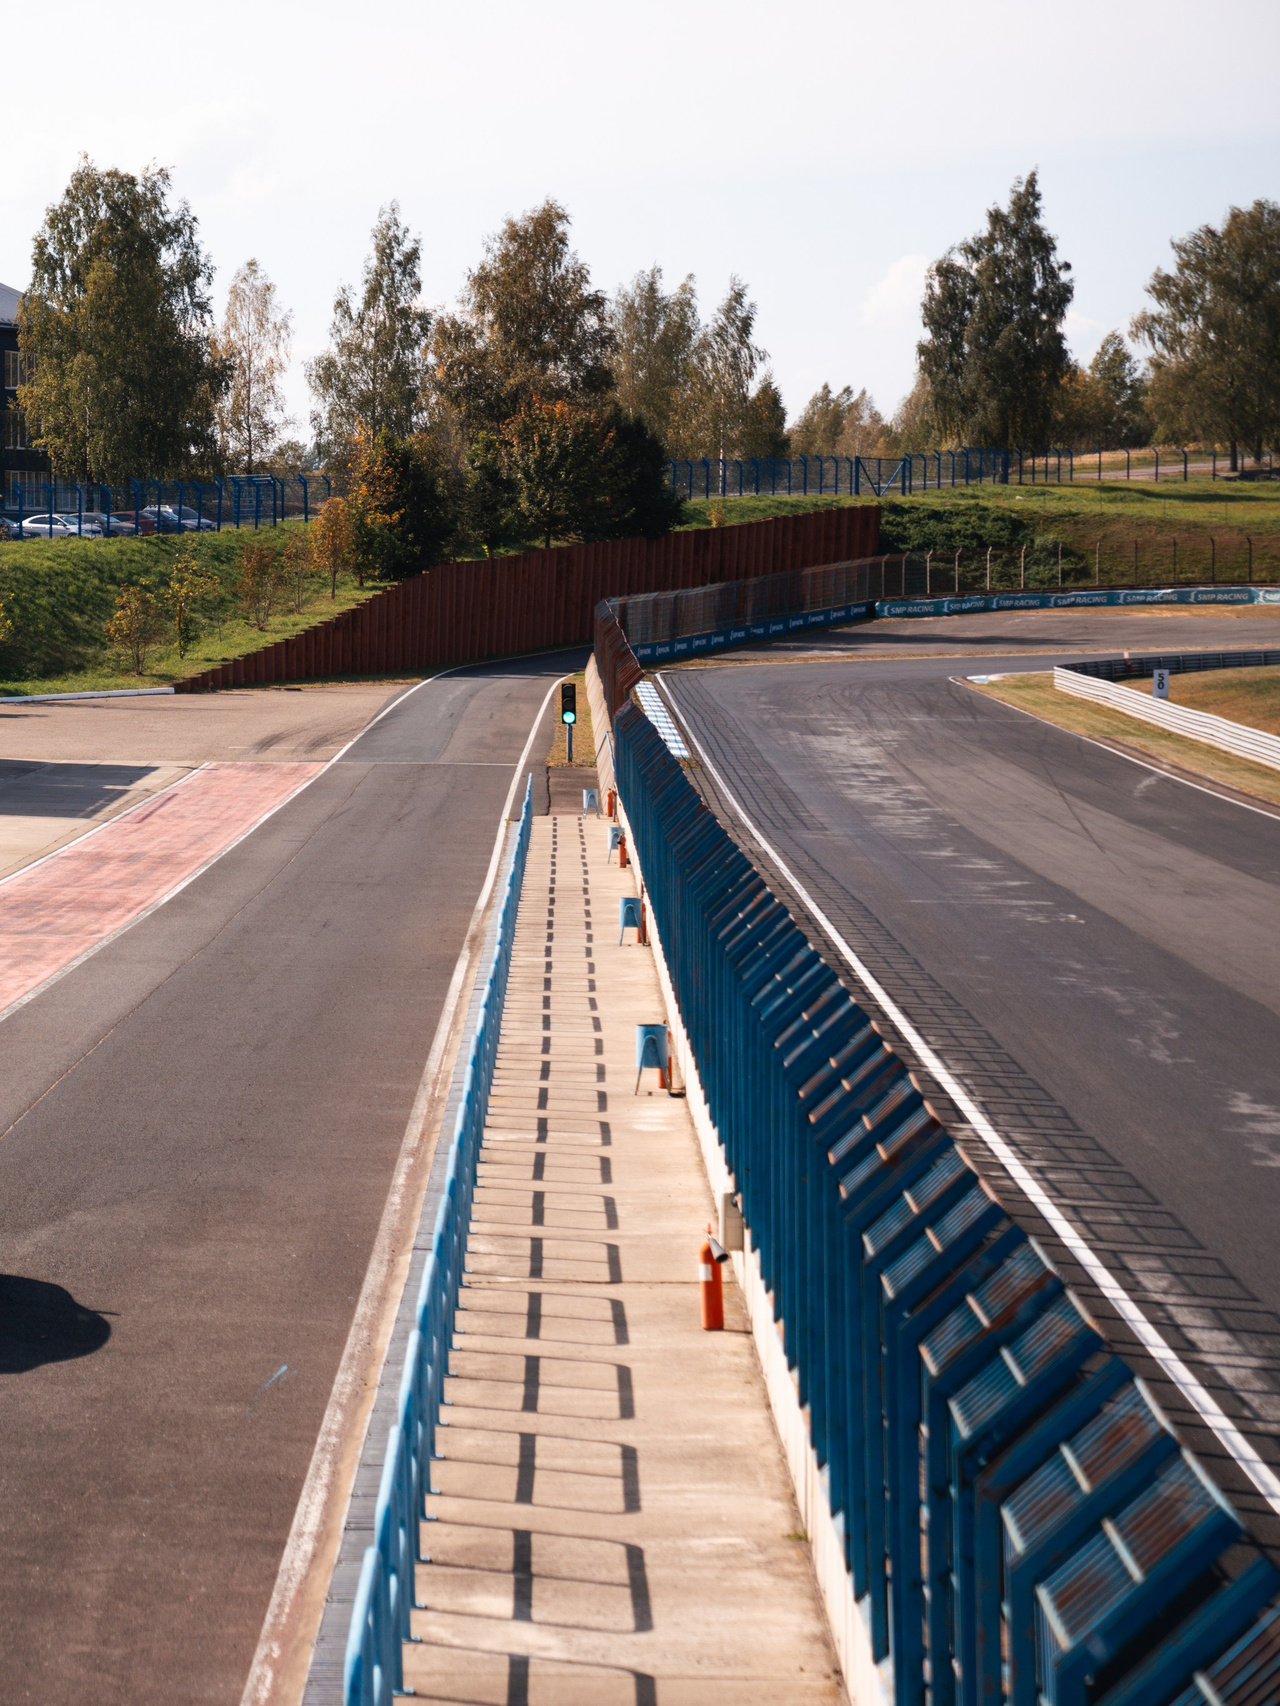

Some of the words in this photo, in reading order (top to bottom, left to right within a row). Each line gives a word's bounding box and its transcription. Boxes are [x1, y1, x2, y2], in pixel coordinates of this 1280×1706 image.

[1057, 598, 1075, 606] SMP
[1076, 596, 1107, 604] RACING
[1126, 594, 1146, 602] SMP
[1146, 593, 1178, 602] RACING
[1197, 594, 1216, 602] SMP
[1217, 592, 1248, 600] RACING
[890, 606, 907, 614] SMP
[907, 604, 934, 613] RACING
[1158, 672, 1164, 690] 50
